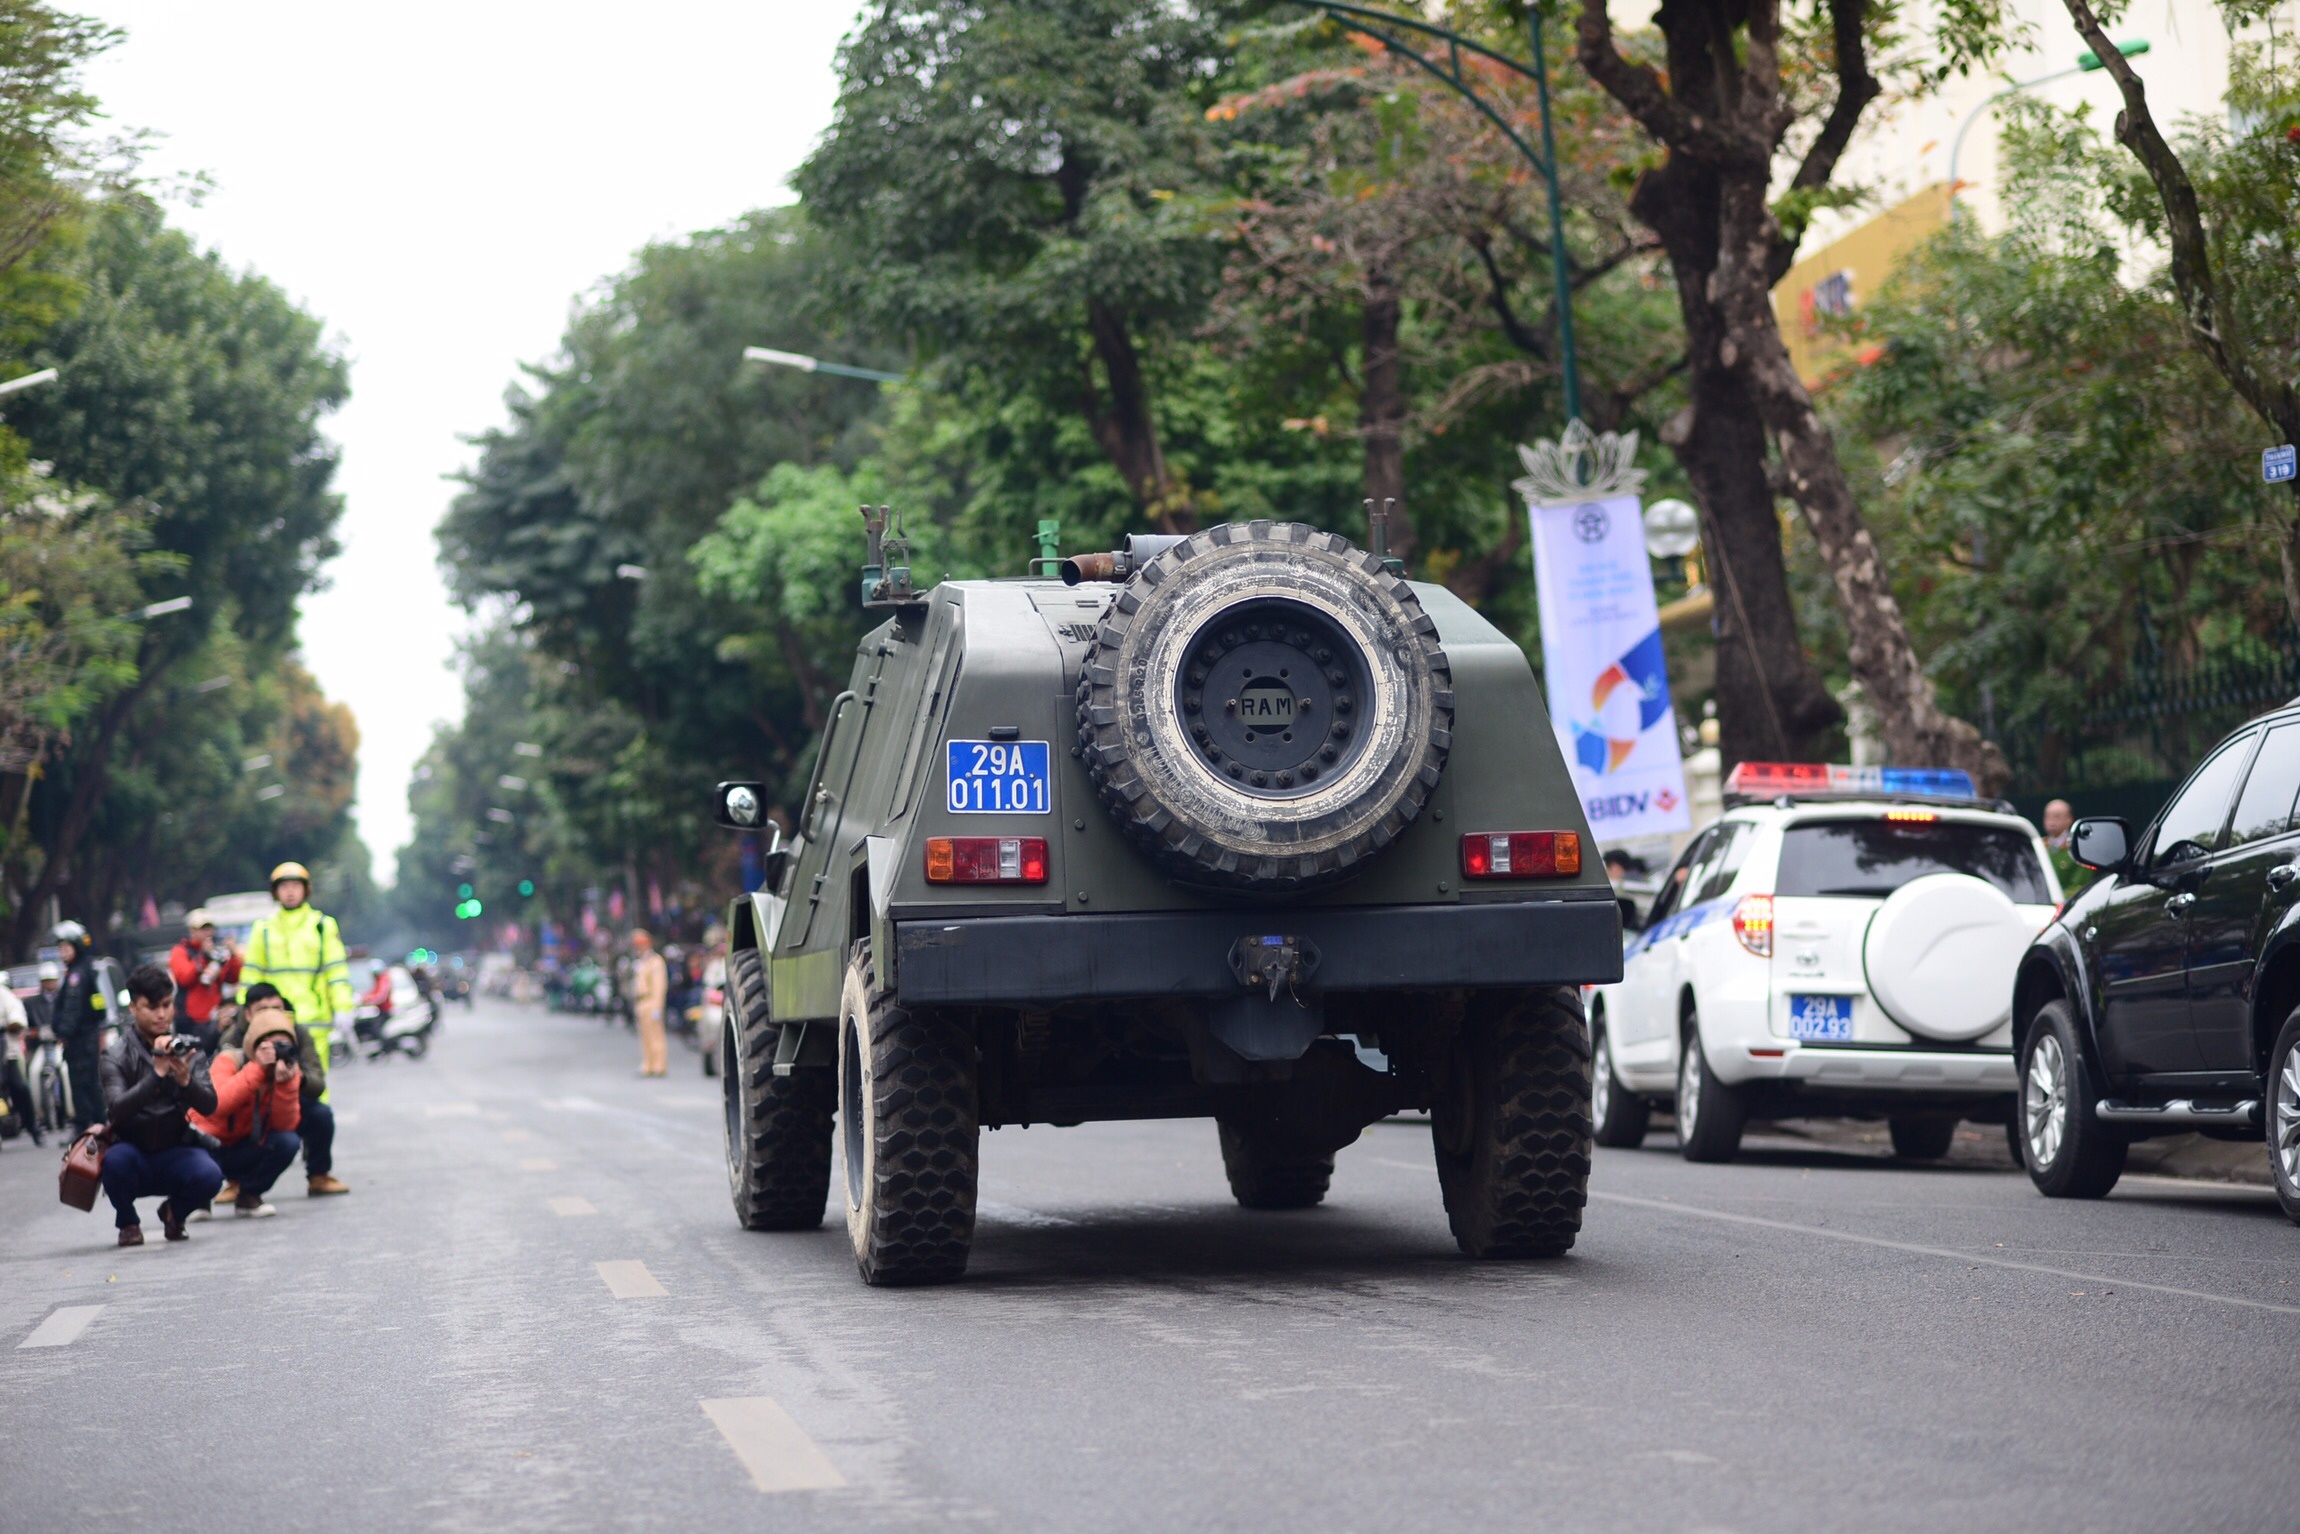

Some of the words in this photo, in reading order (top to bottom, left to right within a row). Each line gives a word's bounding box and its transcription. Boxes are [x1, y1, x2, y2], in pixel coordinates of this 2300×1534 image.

[1241, 697, 1291, 716] RAM
[971, 744, 1025, 776] 29A
[951, 778, 1043, 810] 011.01
[1588, 791, 1649, 822] BIDV
[1802, 997, 1838, 1018] 29A
